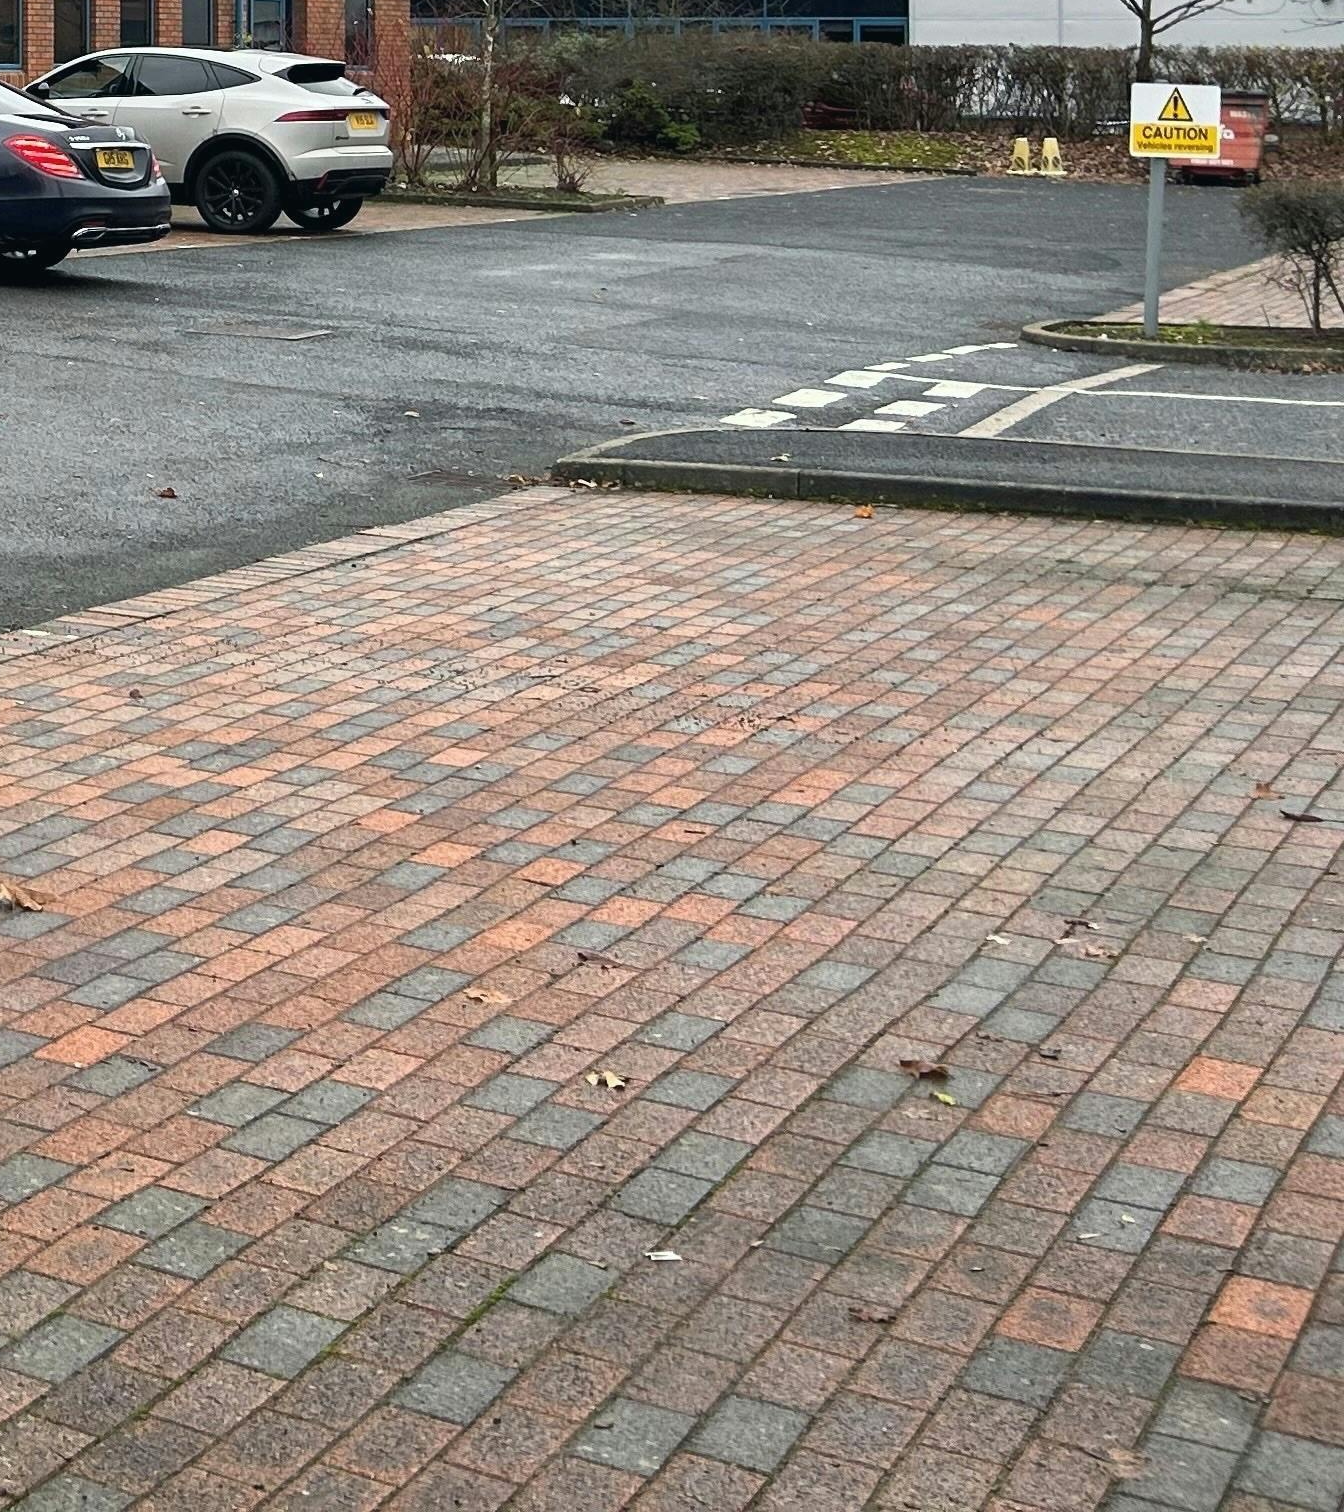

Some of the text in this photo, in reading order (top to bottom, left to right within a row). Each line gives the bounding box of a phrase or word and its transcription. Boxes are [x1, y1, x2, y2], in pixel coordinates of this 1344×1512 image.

[1142, 126, 1208, 141] CAUTION
[1137, 142, 1214, 153] Vehicles reversing
